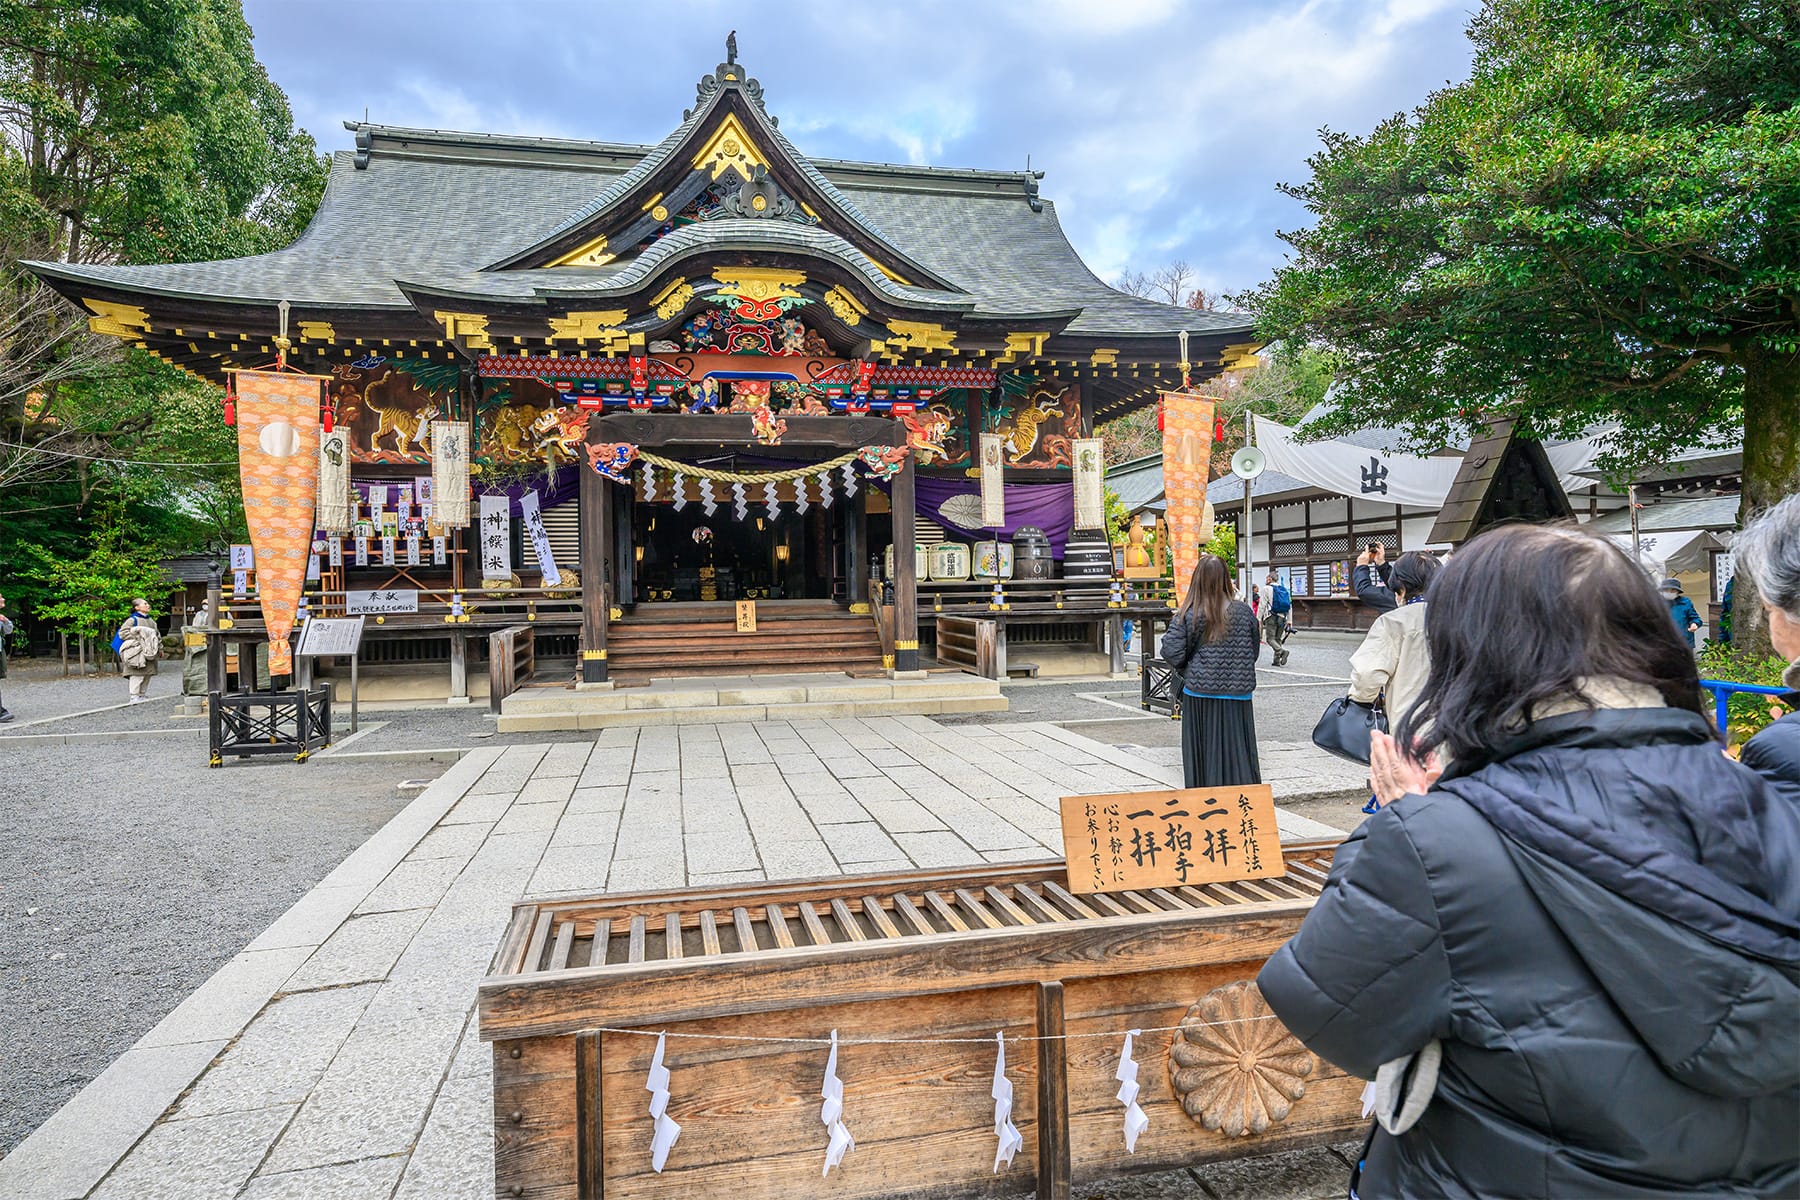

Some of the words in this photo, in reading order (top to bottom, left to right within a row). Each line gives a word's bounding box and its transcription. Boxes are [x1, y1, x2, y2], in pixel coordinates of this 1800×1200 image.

[1360, 456, 1388, 495] 出
[487, 511, 504, 570] 神饌米
[368, 591, 399, 602] 奉献
[1085, 802, 1105, 889] お参り下さい
[1104, 804, 1124, 882] 心お静かに
[1126, 808, 1162, 867] 一拝
[1159, 799, 1194, 883] 二拍手
[1198, 798, 1237, 866] 二拝
[1238, 794, 1263, 873] 参拝作法
